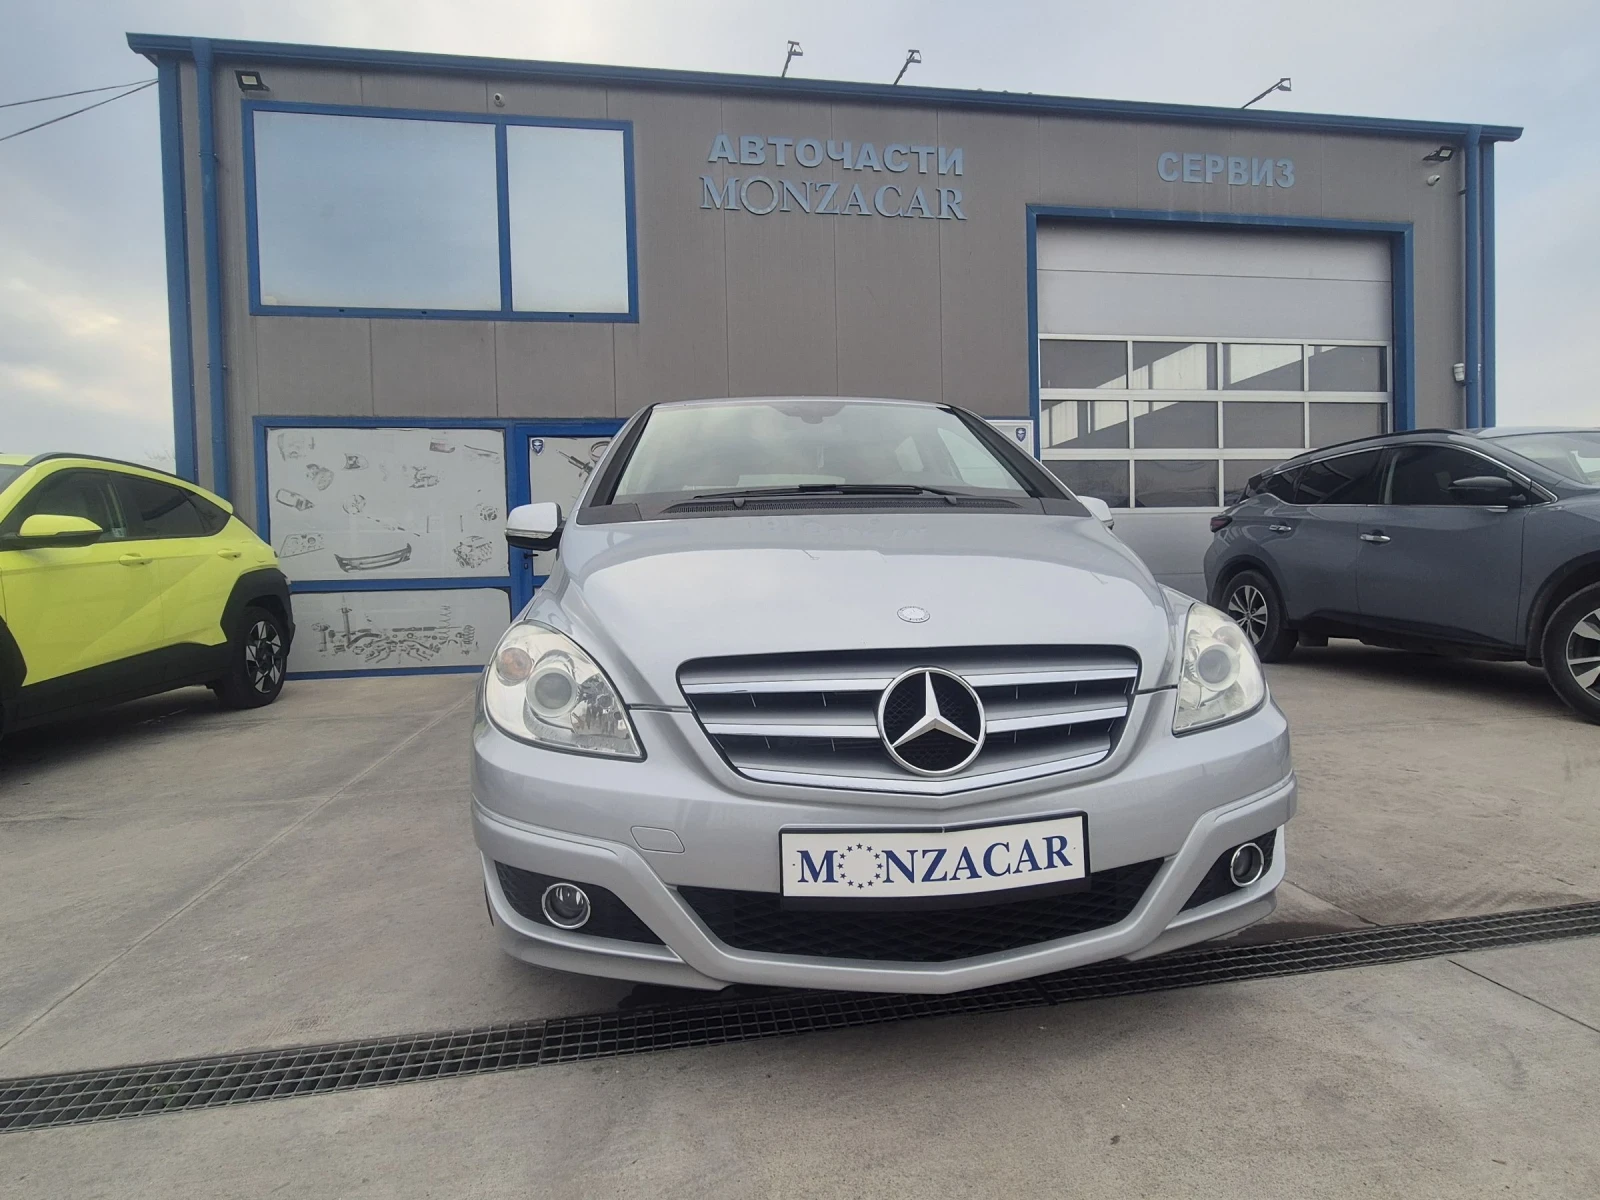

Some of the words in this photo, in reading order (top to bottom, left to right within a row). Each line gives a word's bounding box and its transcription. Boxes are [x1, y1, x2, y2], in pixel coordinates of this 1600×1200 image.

[708, 133, 964, 176] АВТОЧАСТИ
[1157, 151, 1295, 189] СЕРВИЗ
[700, 176, 967, 221] MONZACAR
